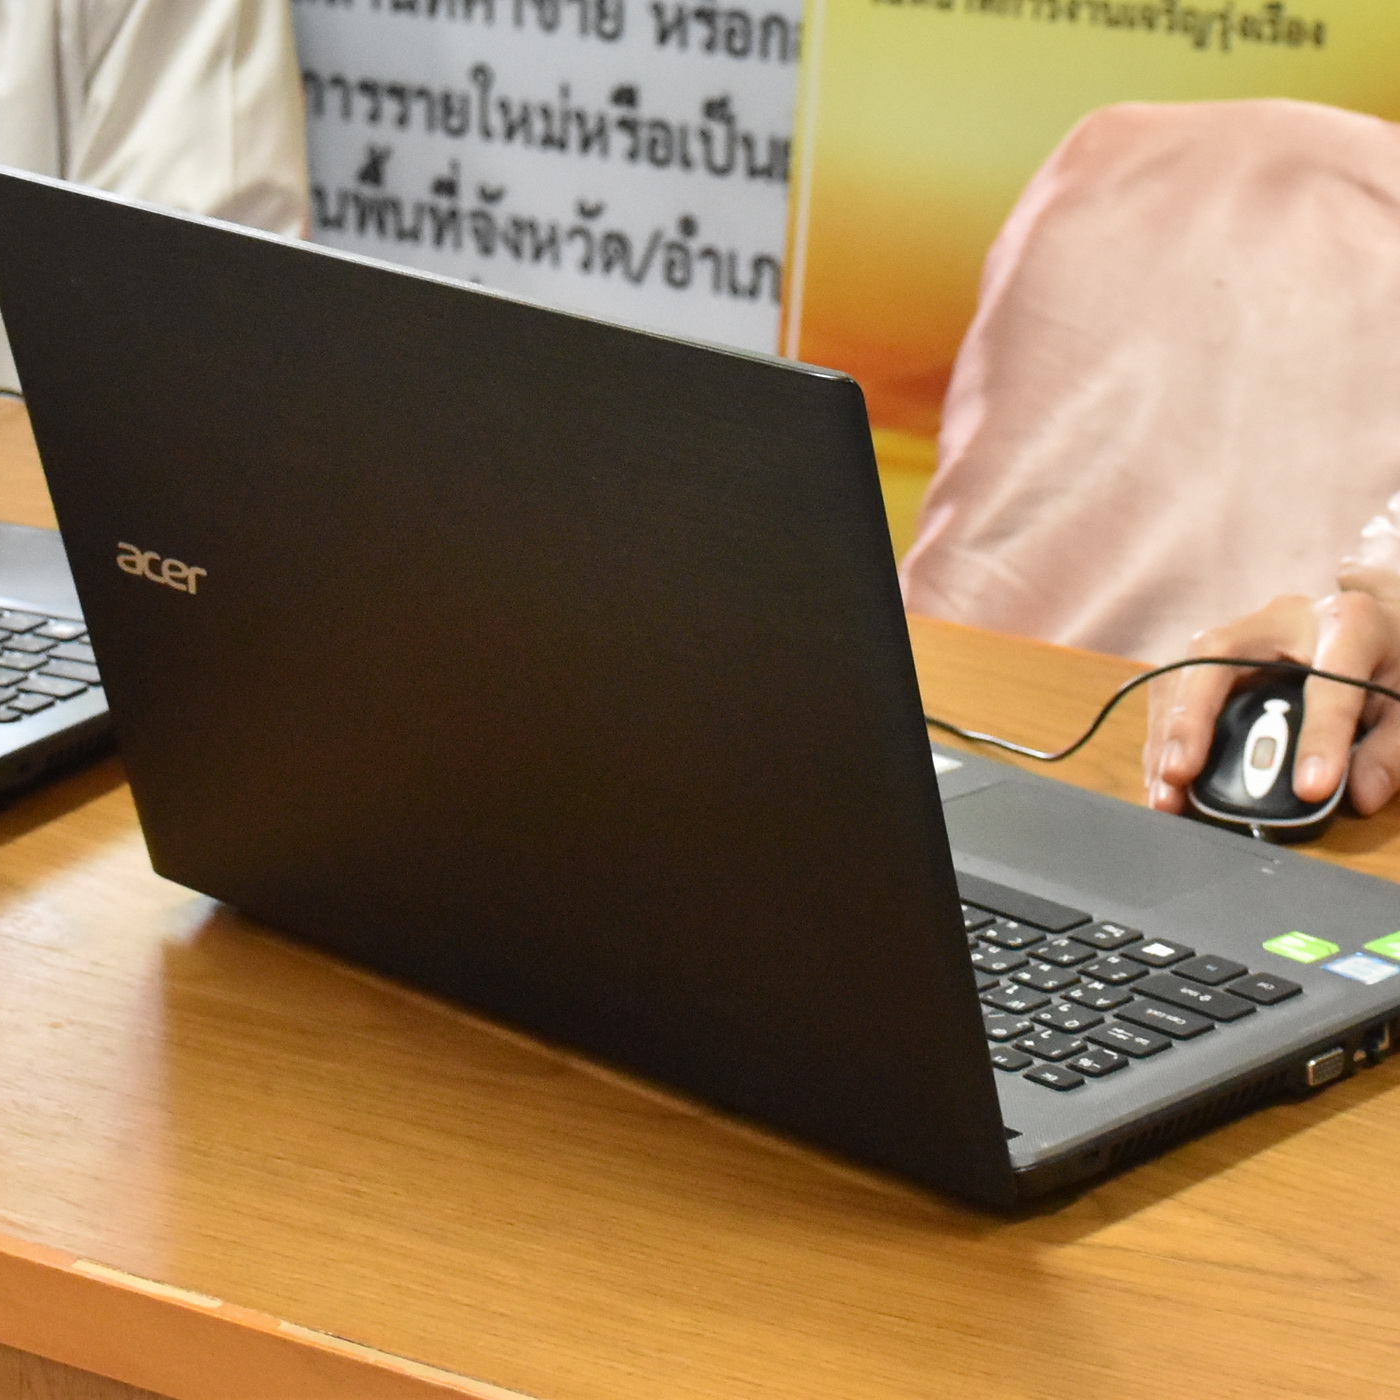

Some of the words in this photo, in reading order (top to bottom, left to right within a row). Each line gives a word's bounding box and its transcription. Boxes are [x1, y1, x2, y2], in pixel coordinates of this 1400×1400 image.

[311, 143, 784, 307] นพื้นที่จังหวัด/อำเภ
[116, 541, 208, 595] acer
